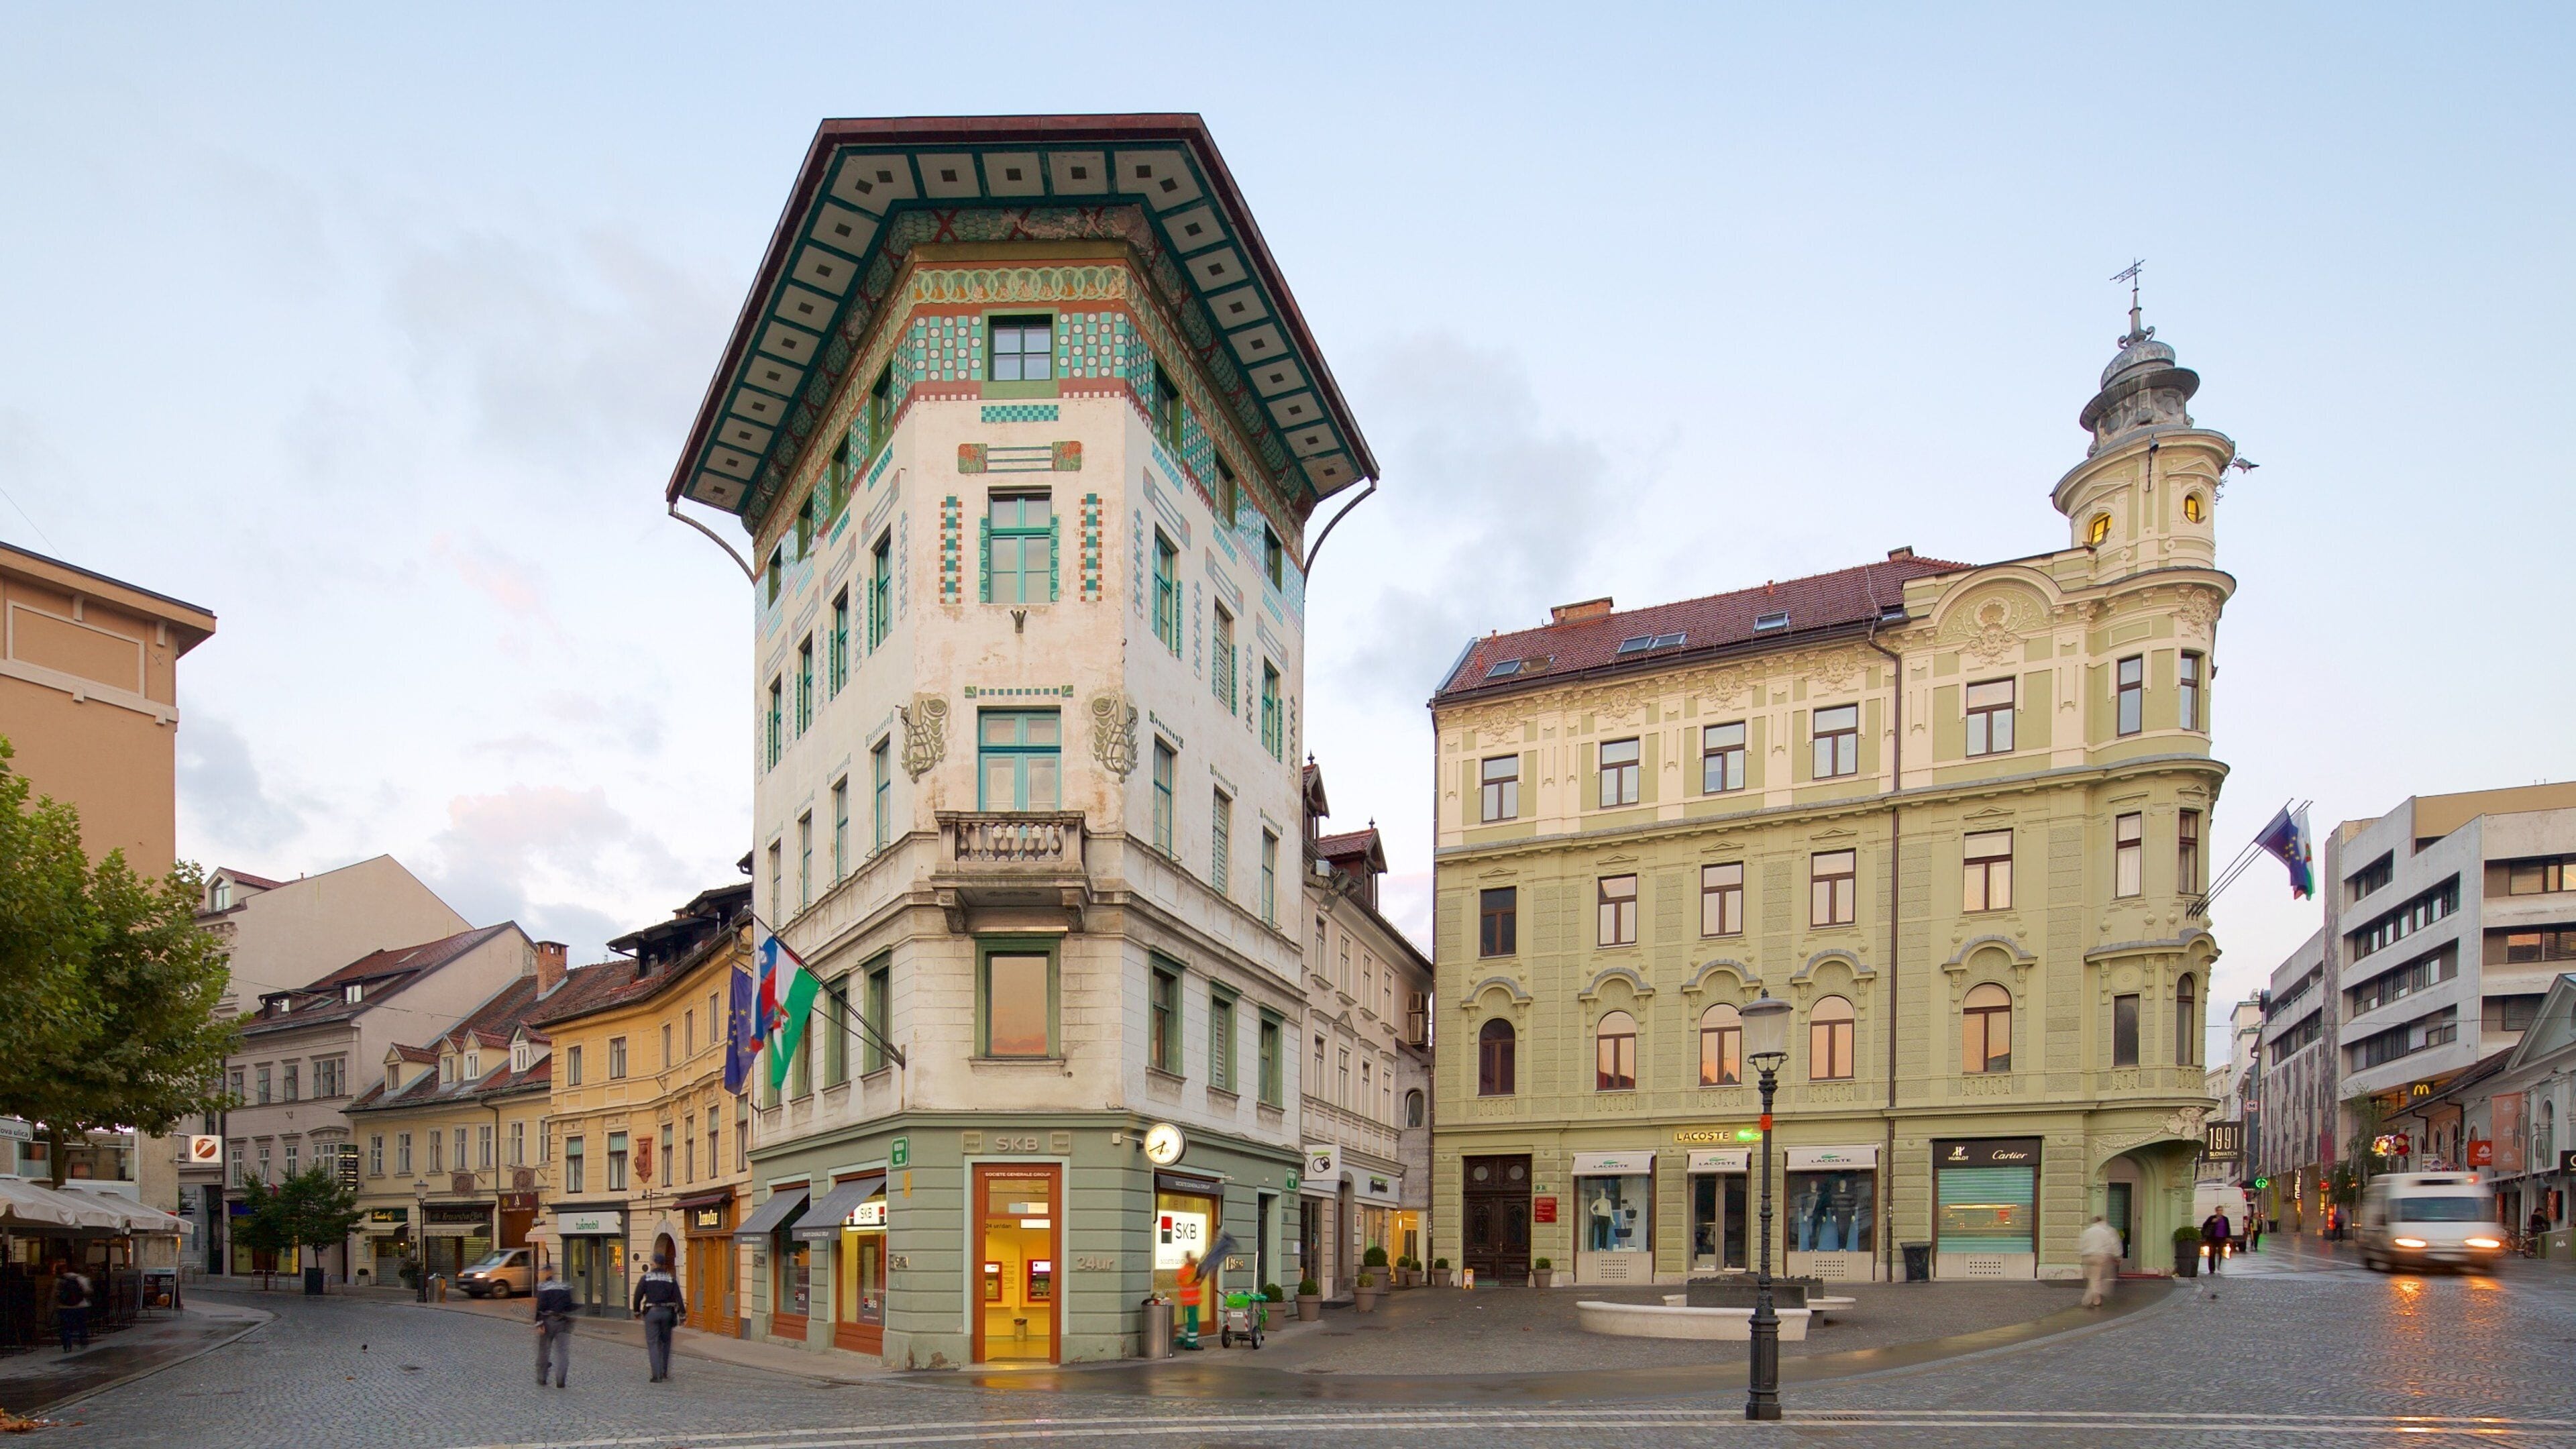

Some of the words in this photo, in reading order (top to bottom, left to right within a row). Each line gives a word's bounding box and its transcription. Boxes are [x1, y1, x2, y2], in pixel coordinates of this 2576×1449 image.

[1676, 1131, 1729, 1141] LACOSTE
[2209, 1127, 2238, 1150] 1991
[996, 1137, 1038, 1152] SKB
[1992, 1150, 2028, 1160] Cartier
[860, 1207, 872, 1219] SKB
[1175, 1222, 1197, 1240] SKB
[1077, 1256, 1114, 1271] 24ur
[868, 1300, 877, 1308] SKB
